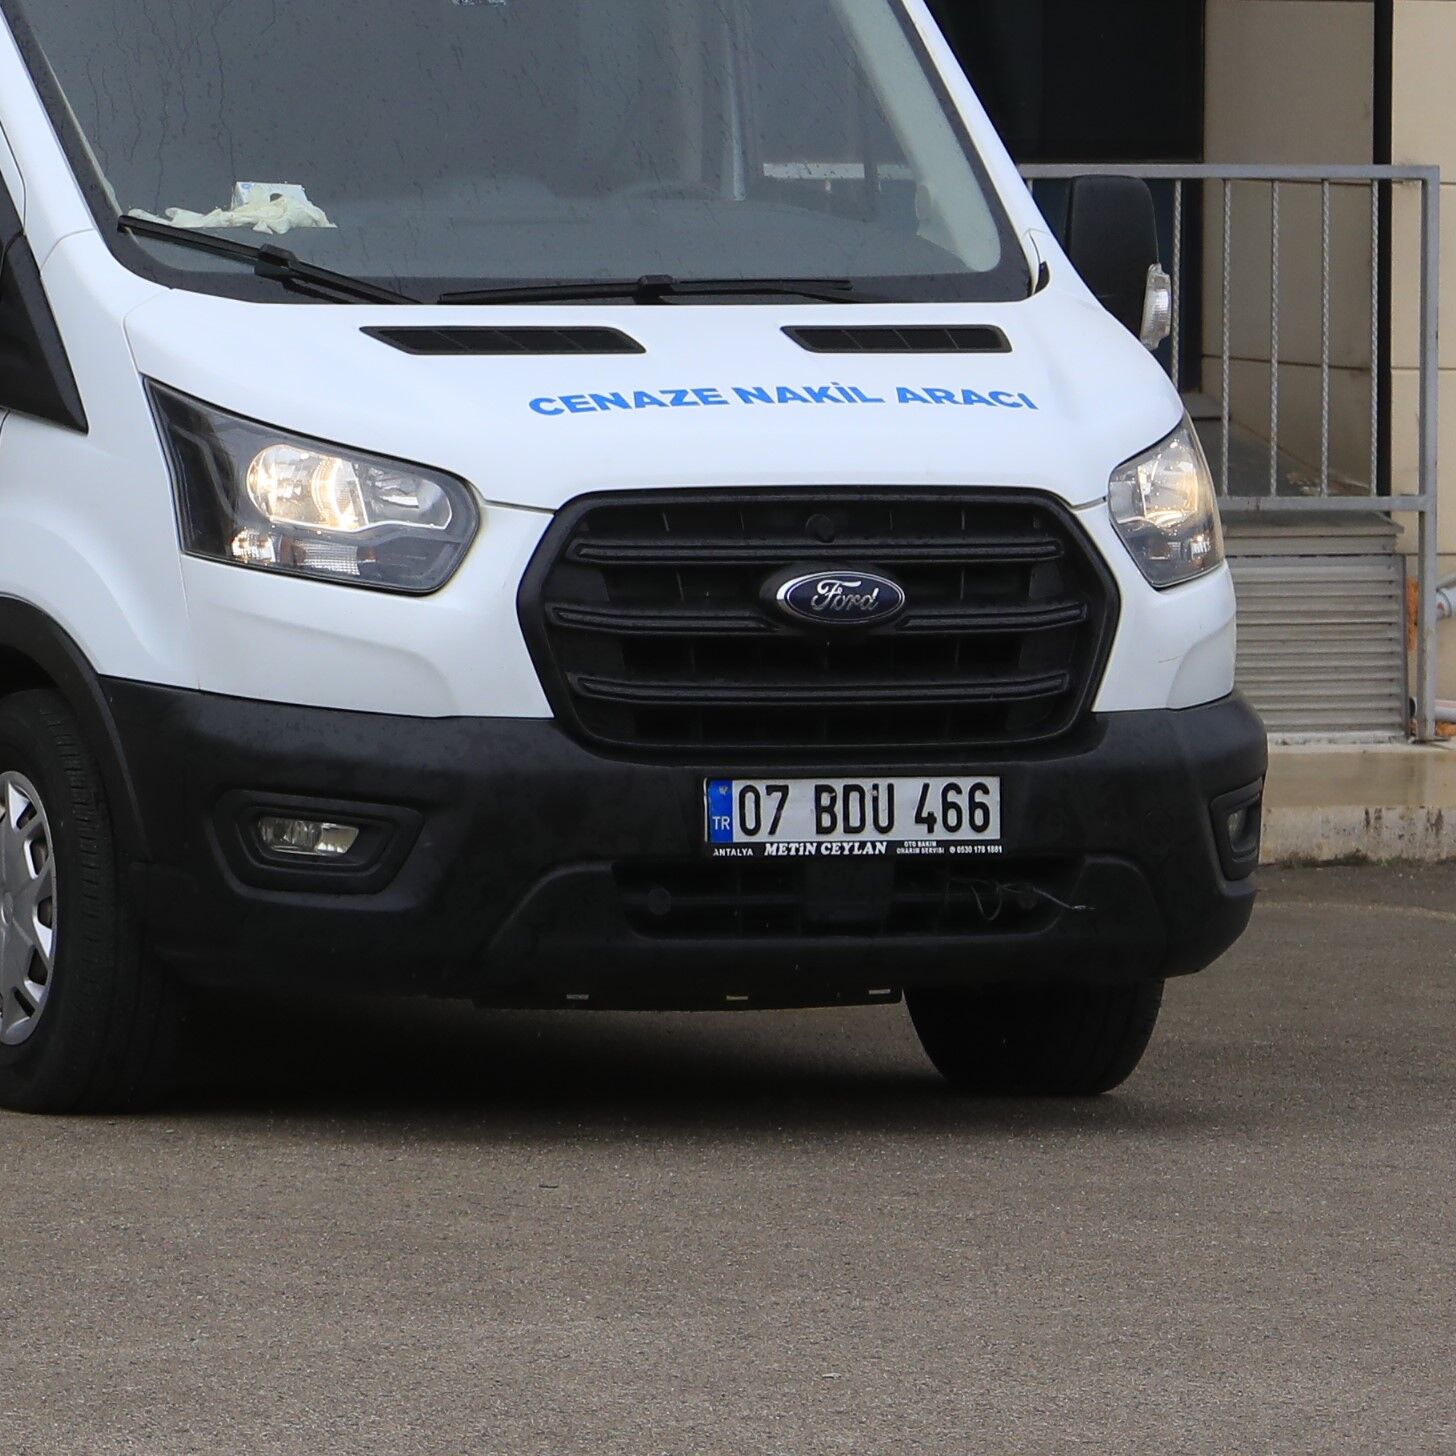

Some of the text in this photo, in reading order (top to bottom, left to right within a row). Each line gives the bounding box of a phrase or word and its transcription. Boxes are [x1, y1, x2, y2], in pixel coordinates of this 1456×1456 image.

[528, 381, 1038, 416] CENAZE NAKİL ARACI
[811, 579, 879, 611] Ford
[739, 782, 990, 836] 07 BDU 466
[712, 815, 730, 830] TR
[713, 848, 753, 856] ANTALYA
[820, 841, 887, 856] CEYLAN
